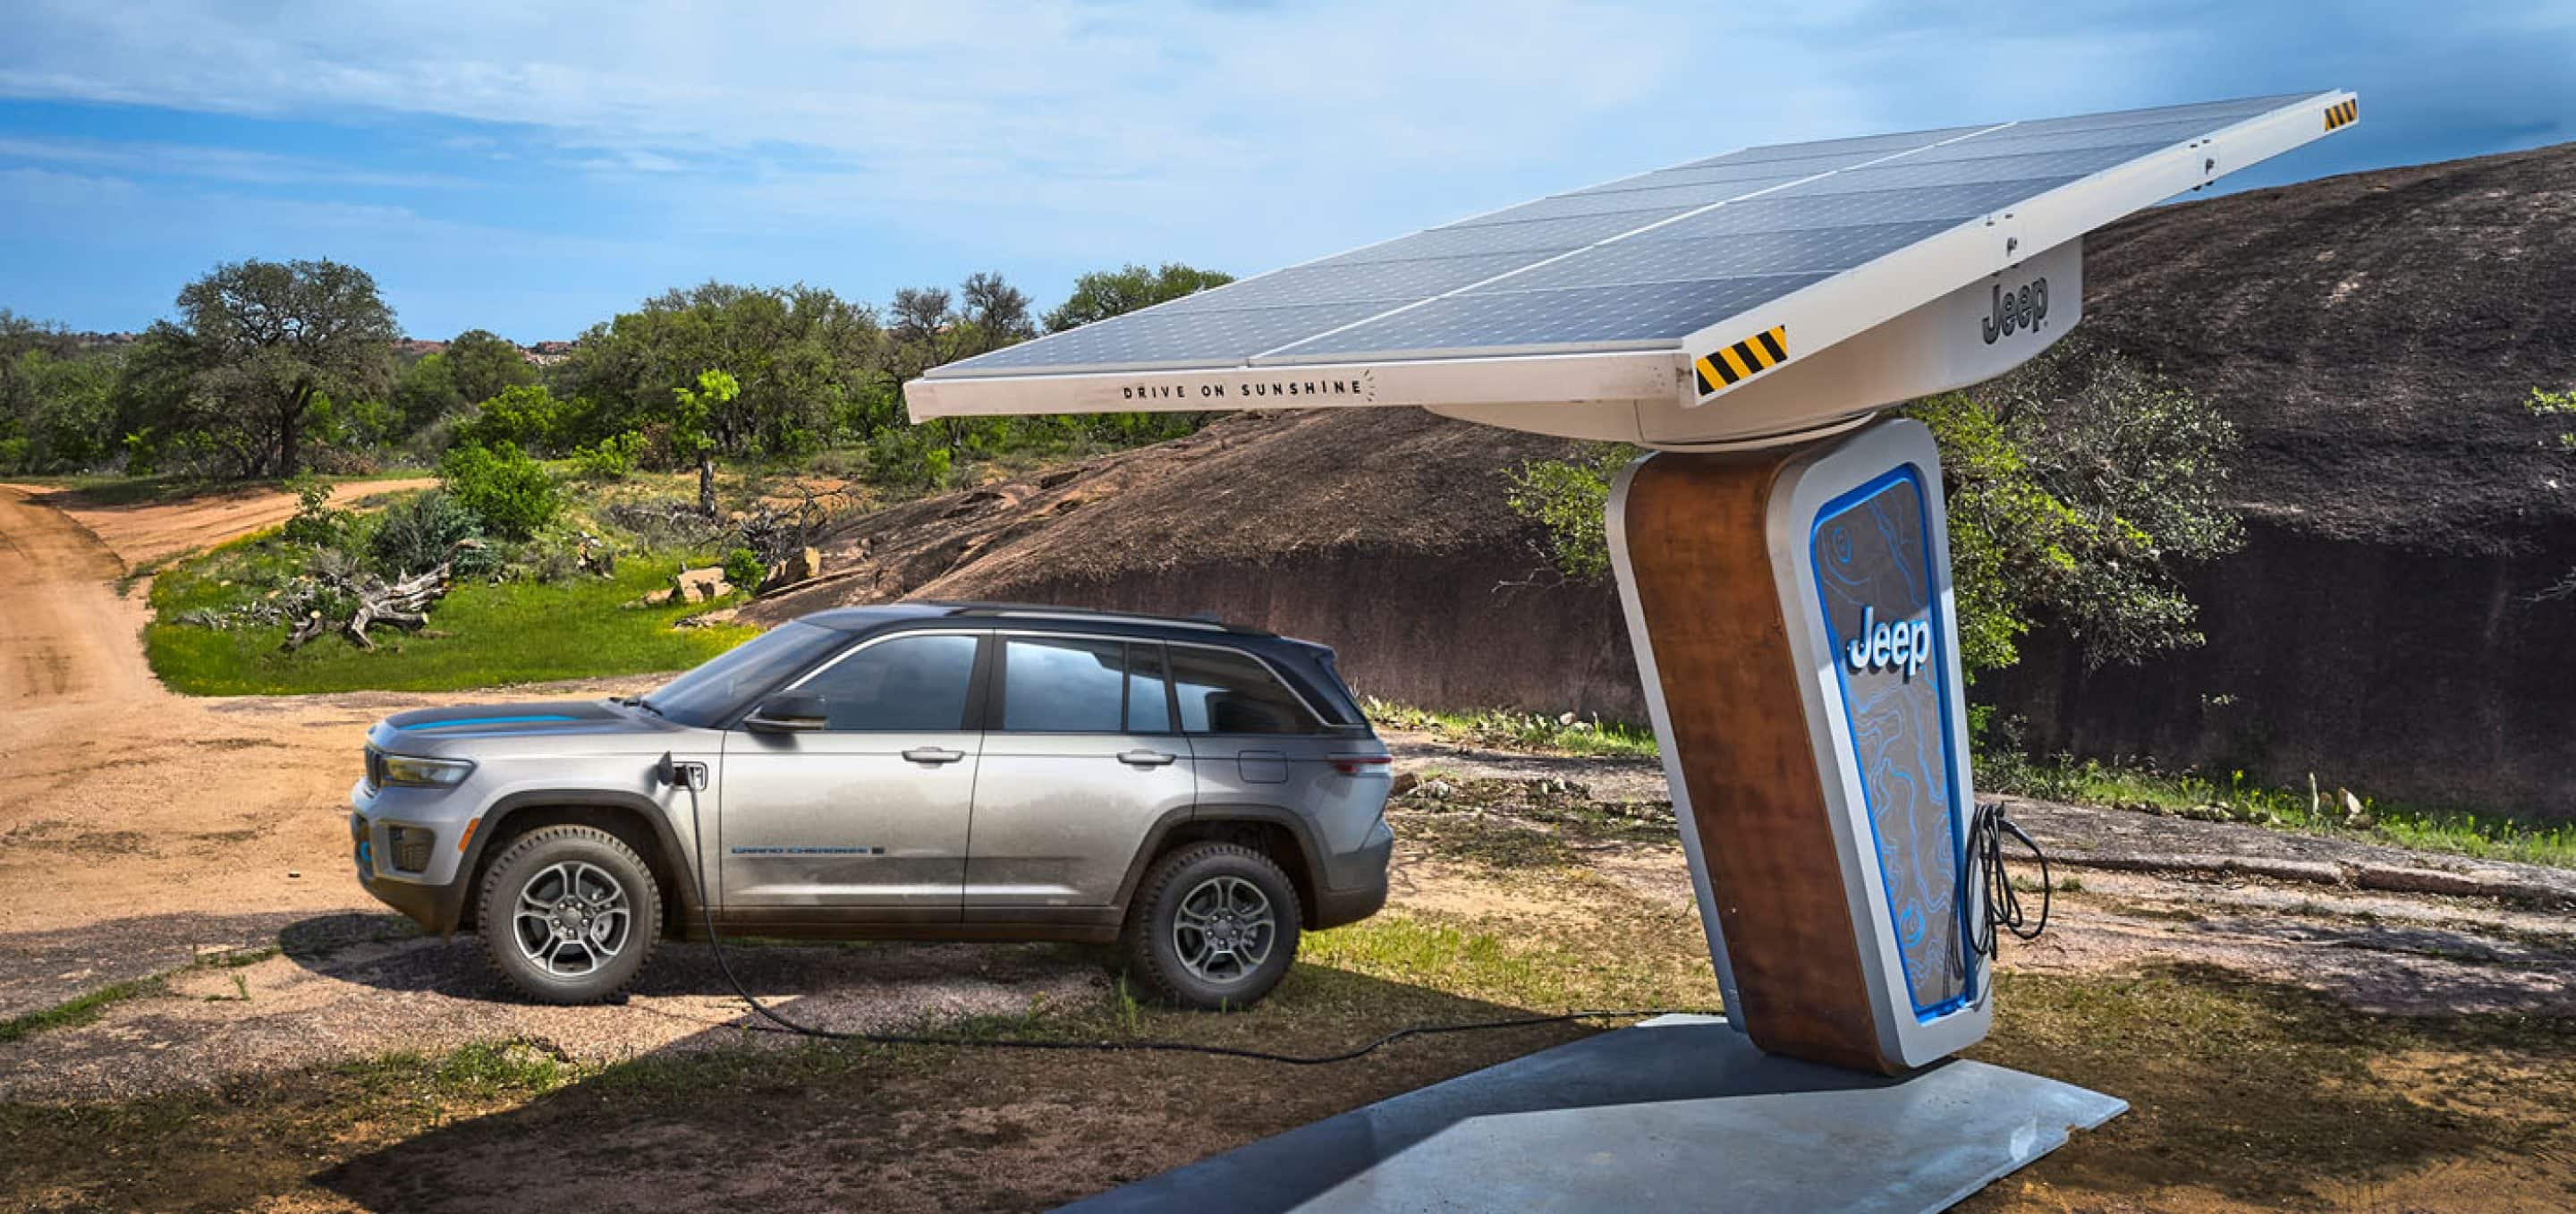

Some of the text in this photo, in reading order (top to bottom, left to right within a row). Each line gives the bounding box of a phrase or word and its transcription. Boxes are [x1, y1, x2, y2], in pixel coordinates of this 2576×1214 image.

[1982, 277, 2048, 344] Jeep
[1123, 380, 1361, 399] DRIVE ON SUNSHINE
[1847, 606, 1930, 677] Jeep
